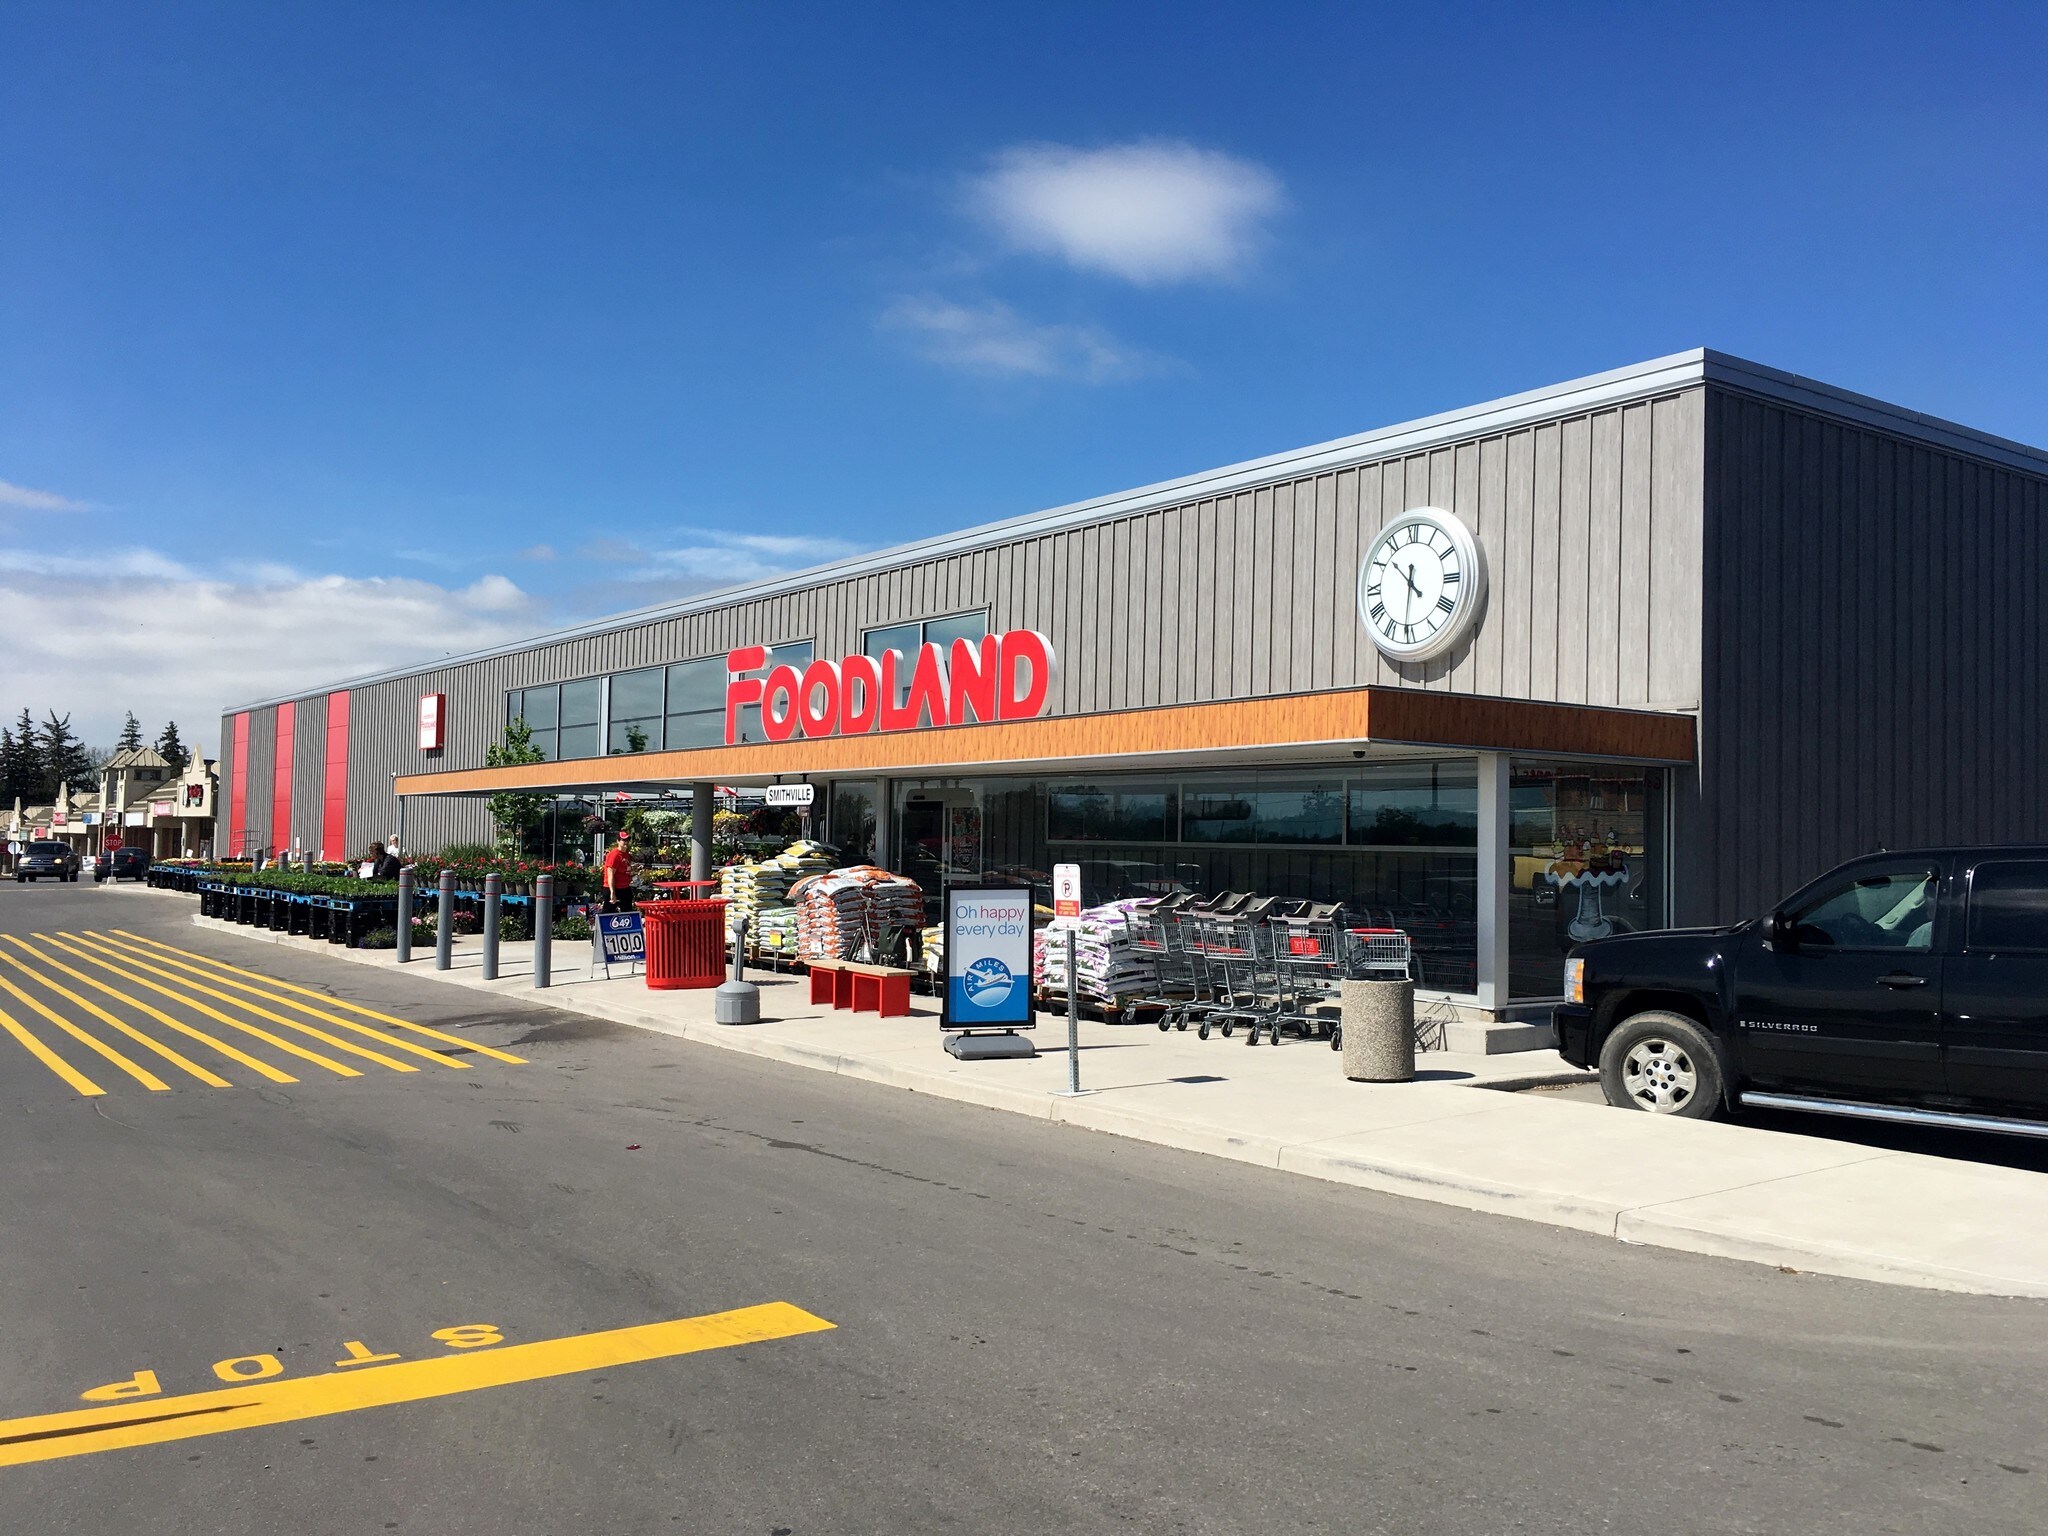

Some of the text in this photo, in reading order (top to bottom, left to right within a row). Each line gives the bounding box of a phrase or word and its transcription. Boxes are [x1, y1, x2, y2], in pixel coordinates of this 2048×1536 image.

[725, 629, 1054, 745] FOODLAND
[769, 788, 811, 801] SMITHVILLE
[955, 905, 1025, 921] Oh happy
[955, 922, 1024, 938] every day
[975, 960, 1005, 971] MILES
[1748, 1021, 1818, 1032] SILVERADO
[81, 1324, 505, 1401] STOP
